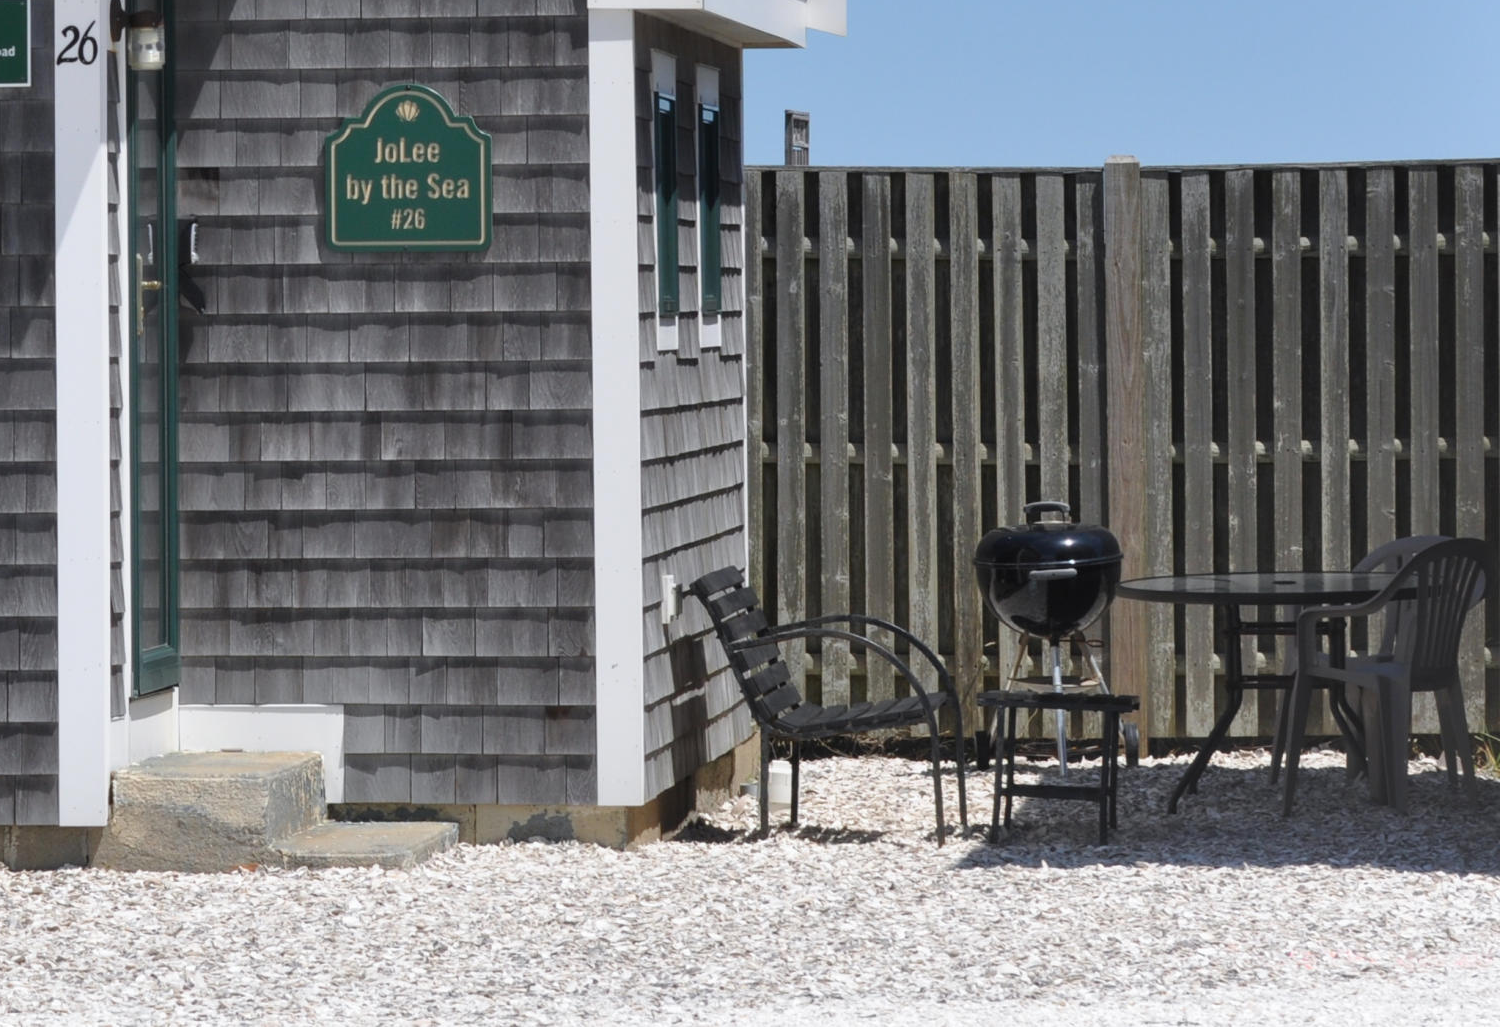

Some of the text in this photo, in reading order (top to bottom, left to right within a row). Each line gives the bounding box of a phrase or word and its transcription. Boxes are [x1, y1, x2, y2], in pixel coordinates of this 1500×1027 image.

[56, 20, 98, 66] 26
[374, 137, 440, 163] JoLee
[346, 173, 470, 205] by the Sea
[391, 208, 426, 230] #26
